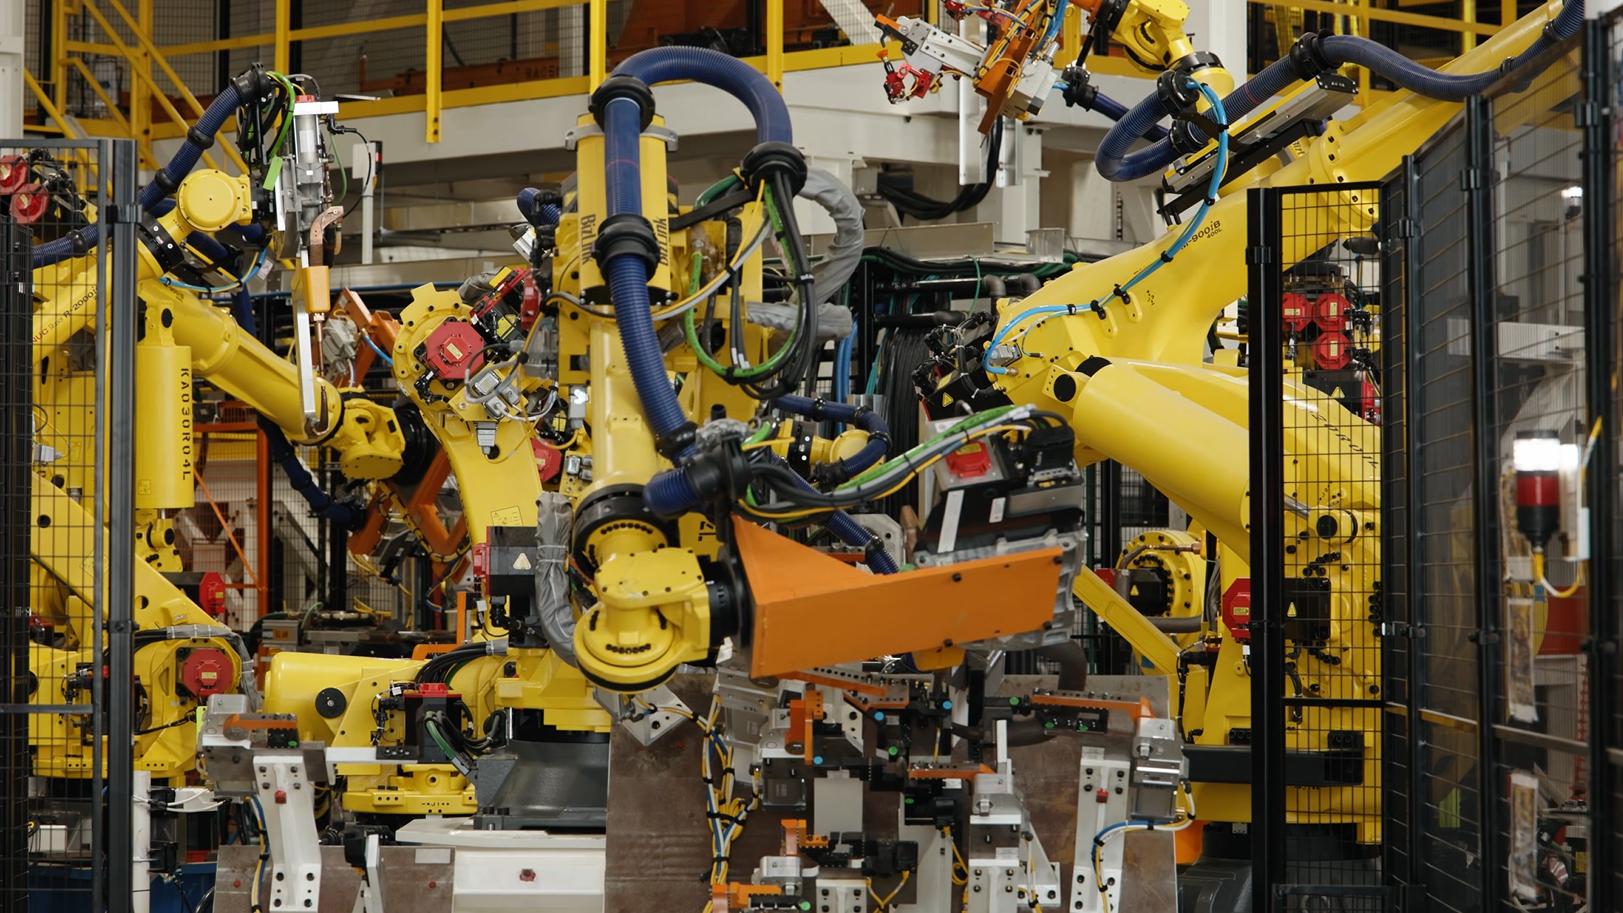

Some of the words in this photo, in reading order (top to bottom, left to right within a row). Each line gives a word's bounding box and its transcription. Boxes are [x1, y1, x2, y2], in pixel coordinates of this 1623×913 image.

[580, 214, 596, 265] BizLink
[63, 286, 97, 318] R-2000i
[181, 368, 191, 480] KA030R04L
